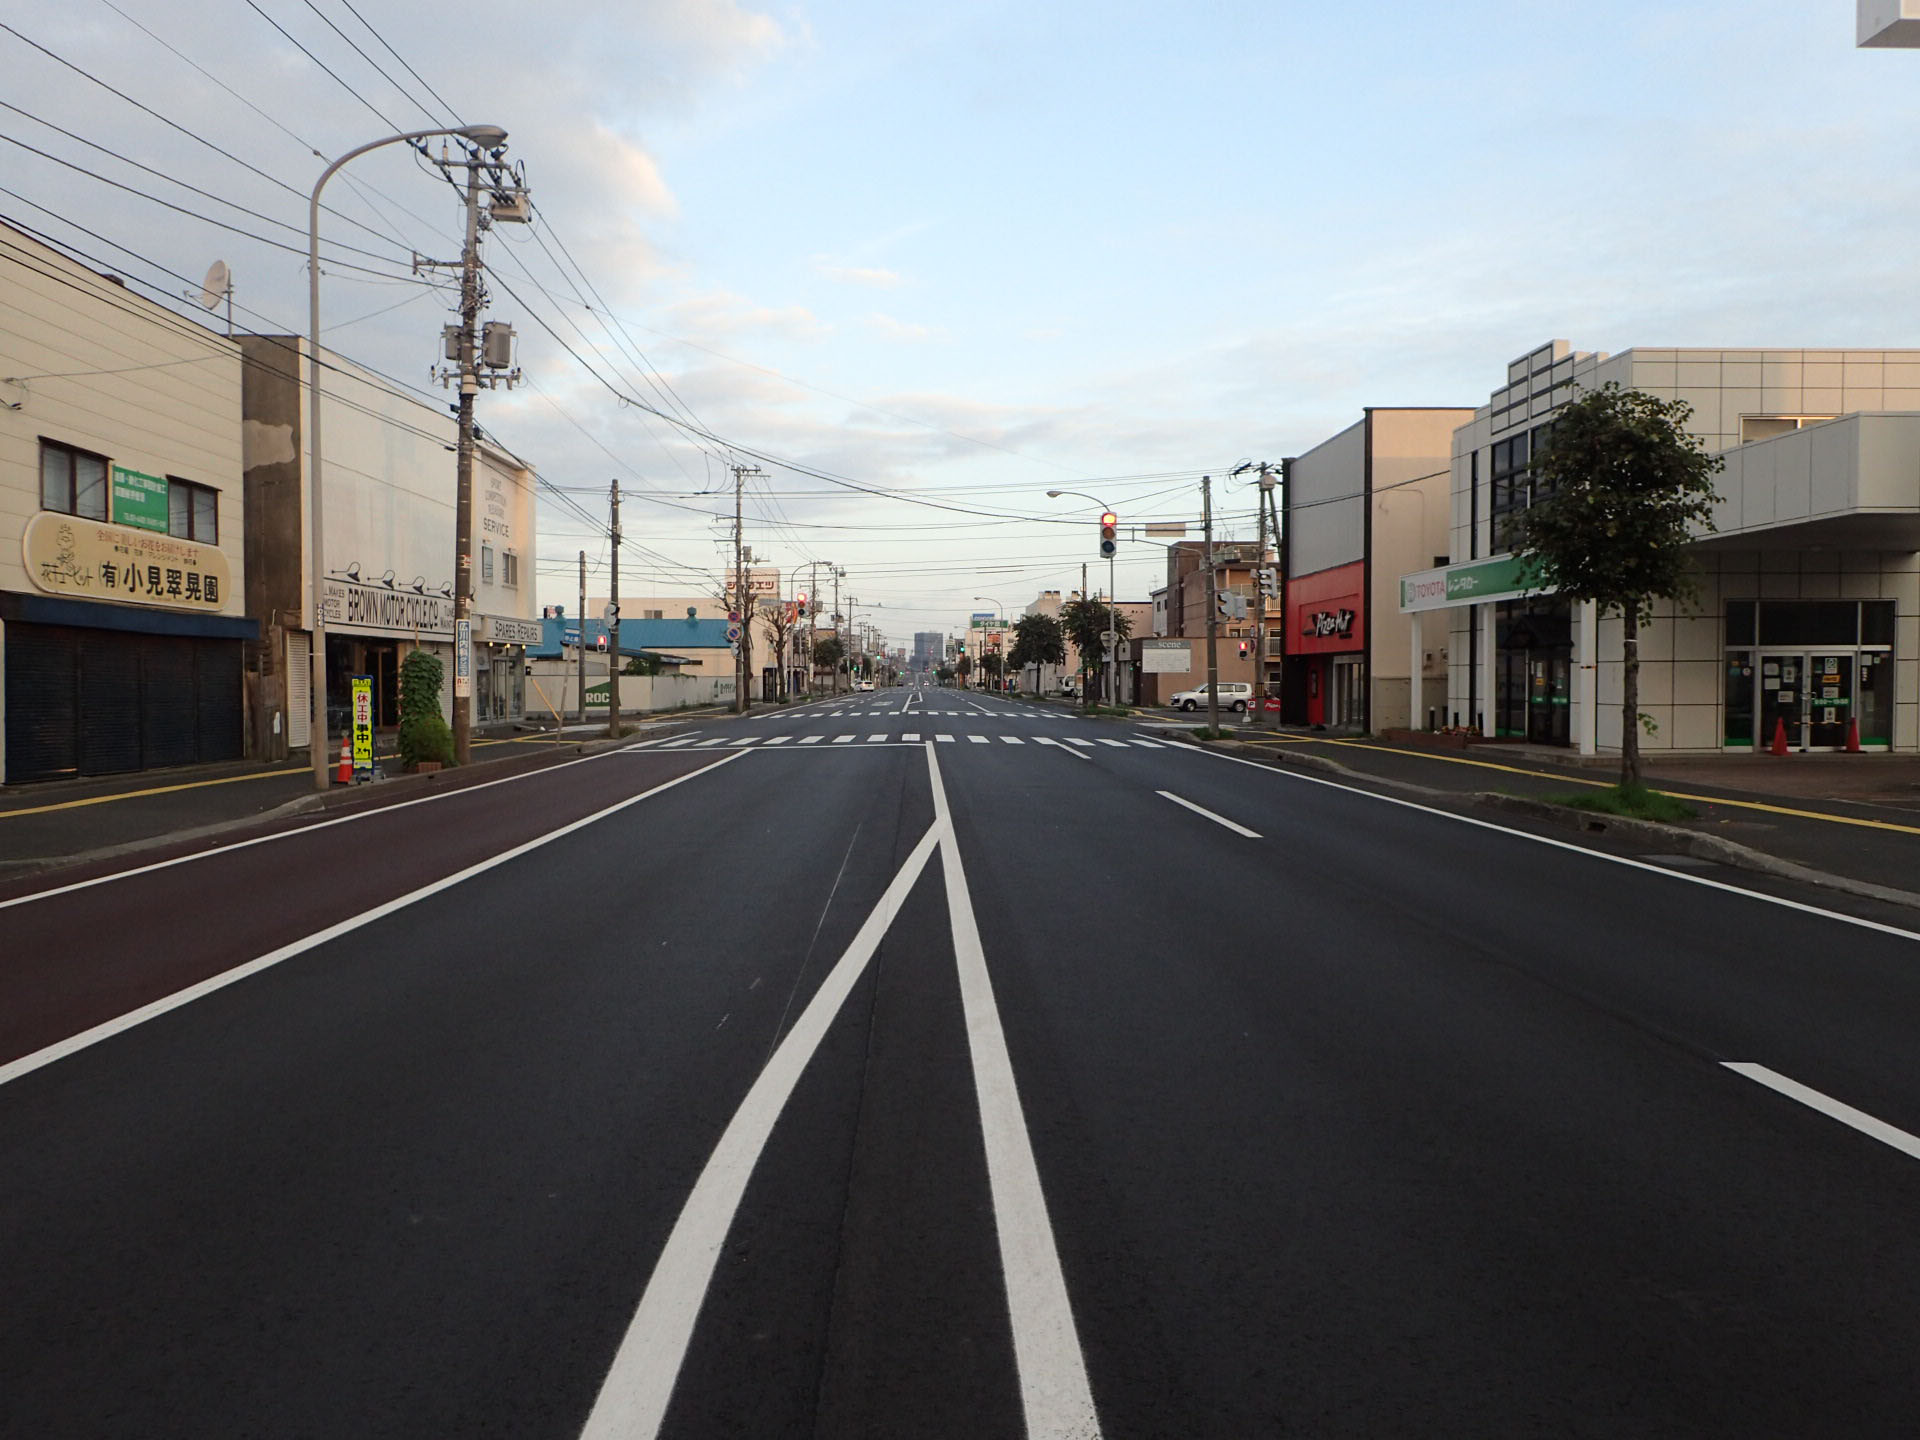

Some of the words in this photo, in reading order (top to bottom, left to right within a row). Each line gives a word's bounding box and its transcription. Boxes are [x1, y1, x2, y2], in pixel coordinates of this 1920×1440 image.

[483, 517, 510, 538] SERVICE
[1416, 581, 1445, 597] TOYOTA
[1448, 576, 1478, 592] レンタカー
[348, 588, 378, 624] BROWN
[380, 593, 405, 626] MOTOR
[495, 620, 516, 640] SPARES
[517, 623, 538, 642] REPAIRS
[1315, 612, 1336, 638] Pizza
[1335, 609, 1352, 633] Hut
[1158, 639, 1183, 649] scene
[357, 693, 369, 724] 休工中
